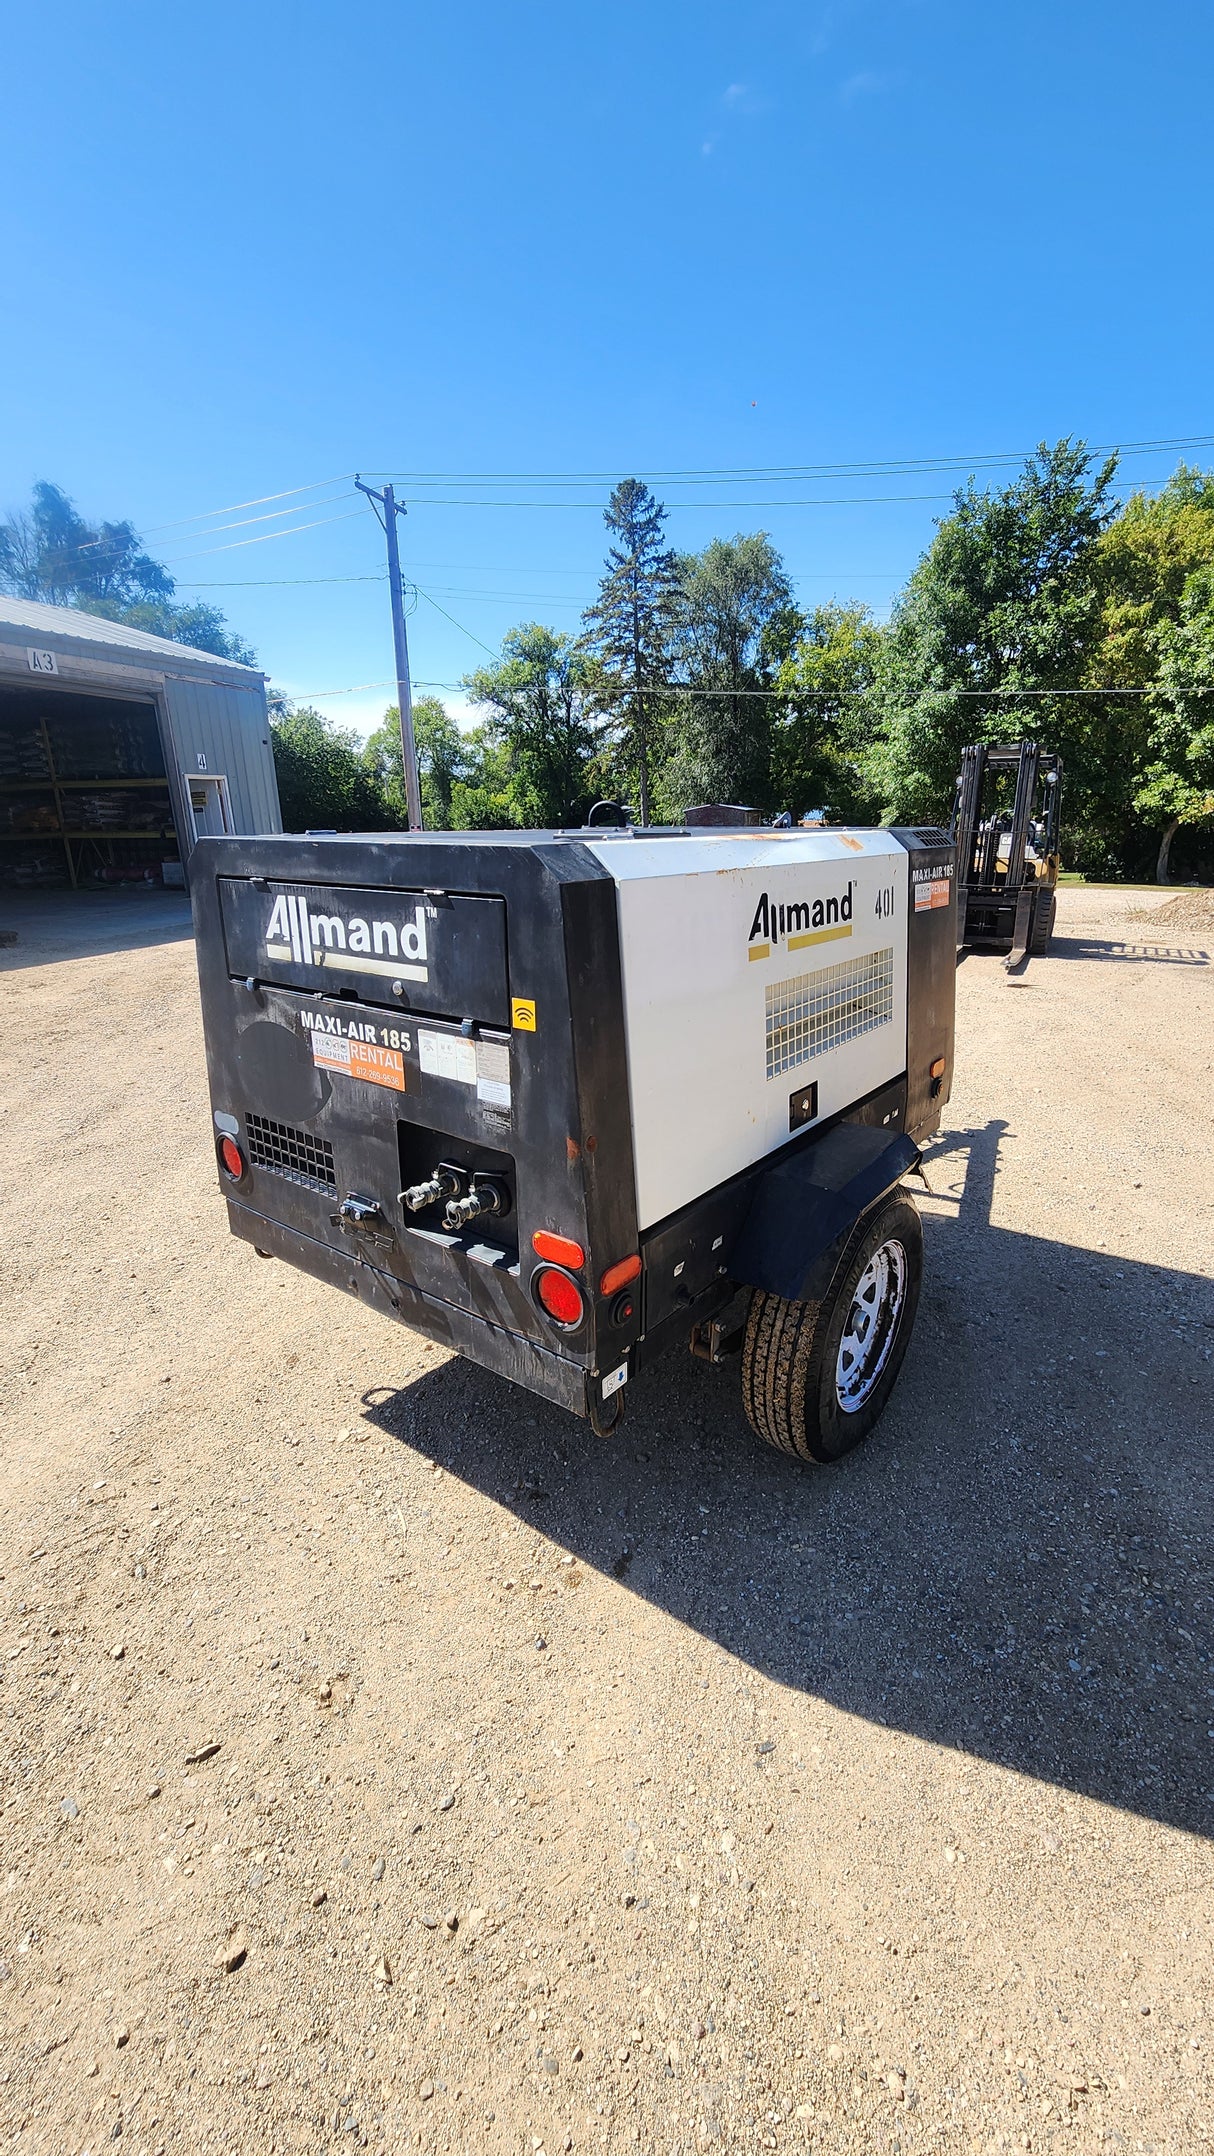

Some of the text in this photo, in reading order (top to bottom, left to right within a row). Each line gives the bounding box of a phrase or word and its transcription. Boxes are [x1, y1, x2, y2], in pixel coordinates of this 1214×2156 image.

[33, 651, 54, 671] A3
[912, 867, 943, 883] MAXI-AIR
[875, 886, 895, 920] 401
[265, 895, 438, 965] Allmand TM
[300, 1010, 377, 1044] MAXI-AIR
[381, 1027, 412, 1053] 185
[315, 1047, 349, 1063] EQUIPMENT
[350, 1043, 404, 1073] RENTAL
